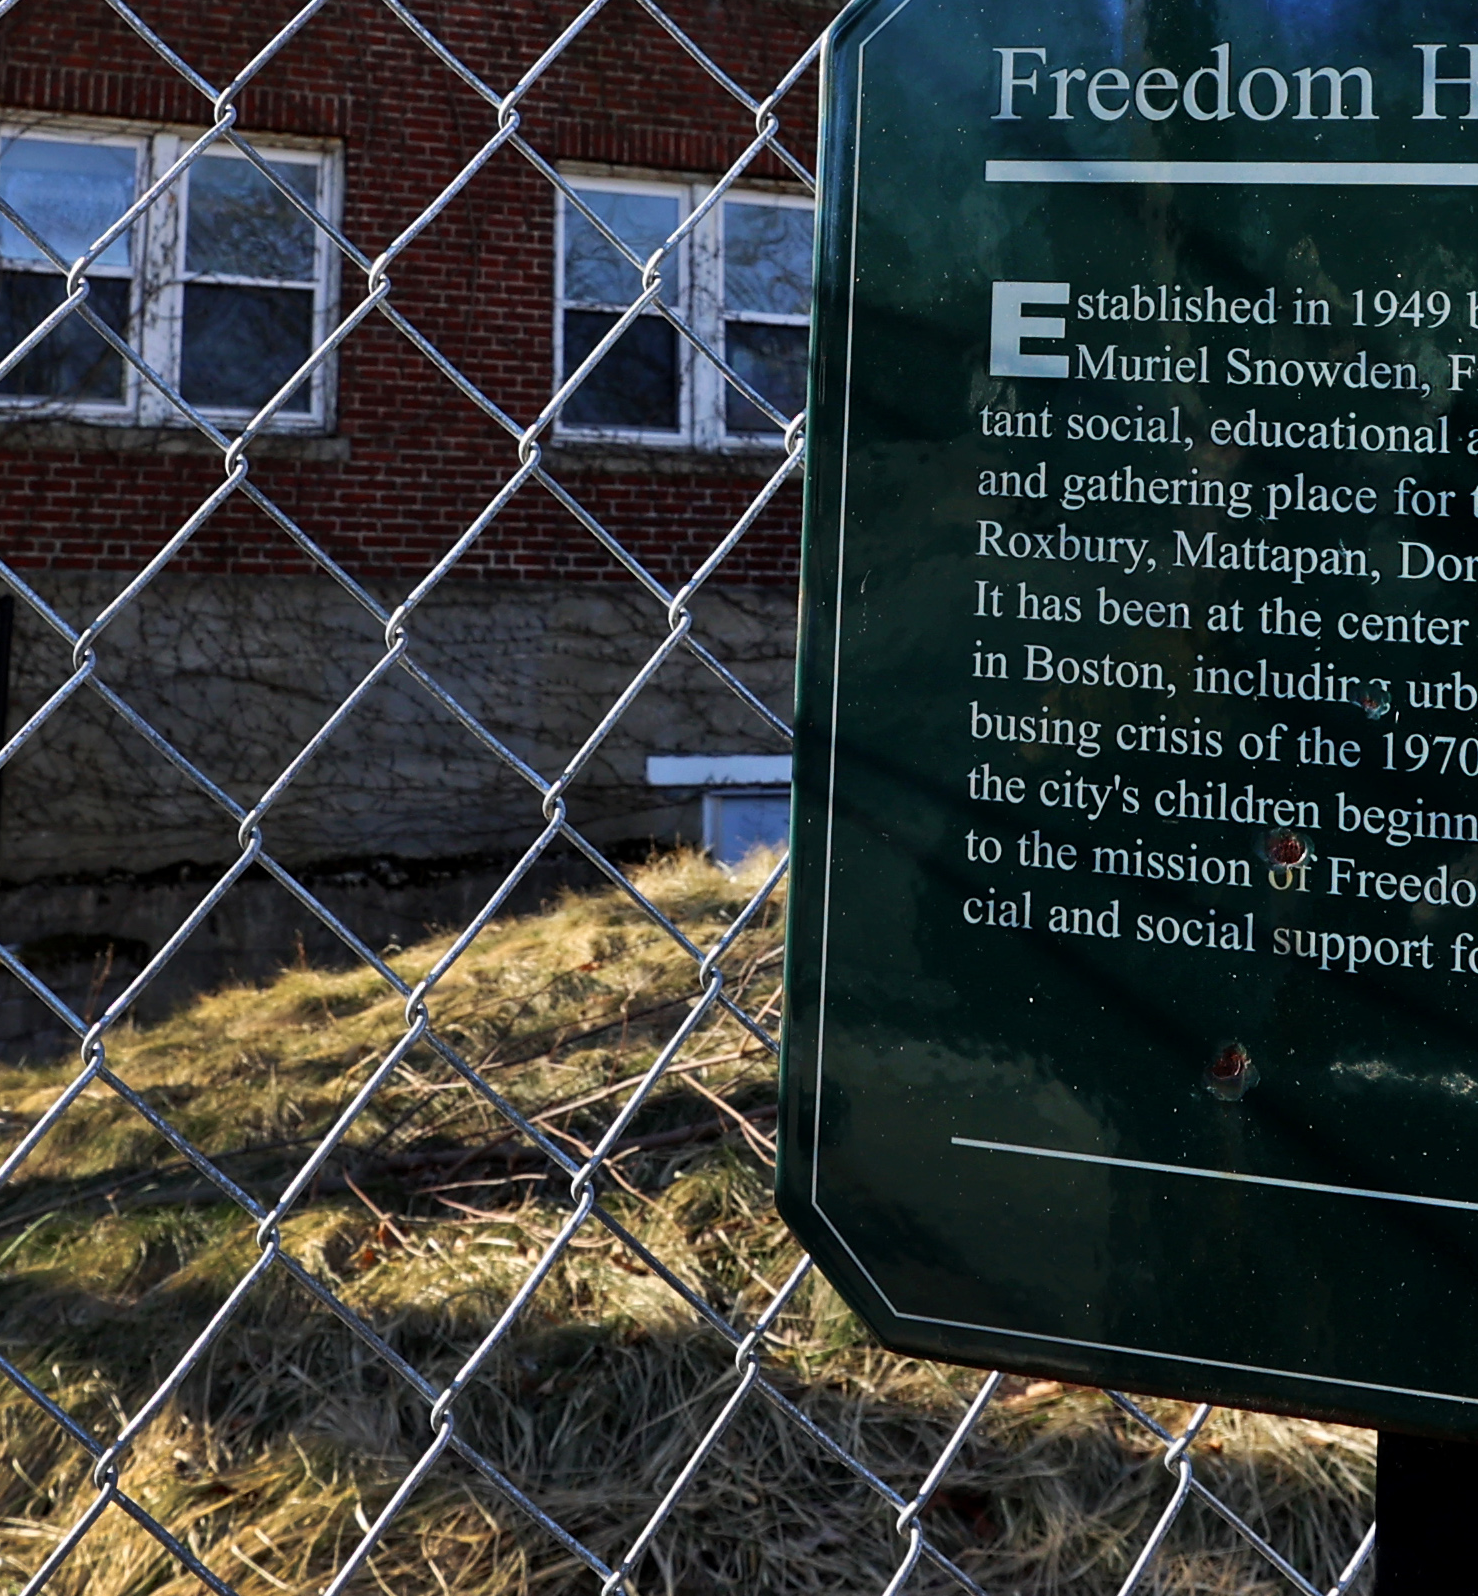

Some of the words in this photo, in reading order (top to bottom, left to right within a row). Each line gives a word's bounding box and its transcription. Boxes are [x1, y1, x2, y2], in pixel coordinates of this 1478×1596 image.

[989, 41, 1380, 122] Freedom
[1292, 286, 1332, 326] in
[1351, 288, 1452, 329] 1949
[1073, 343, 1211, 384] Muriel
[1226, 347, 1431, 399] Snowden,
[978, 401, 1054, 441] tant
[1066, 404, 1194, 452] social,
[1210, 408, 1451, 454] educational
[977, 460, 1049, 499] and
[1058, 464, 1254, 519] gathering
[1265, 472, 1378, 521] place
[1393, 476, 1457, 517] for
[974, 519, 1157, 575] Roxbury,
[1171, 529, 1381, 586] Mattapan,
[973, 579, 1004, 618] It
[1015, 581, 1082, 623] has
[1095, 585, 1193, 630] been
[1206, 599, 1245, 633] at
[1257, 596, 1322, 638] the
[1337, 609, 1470, 646] center
[971, 639, 1010, 680] in
[1022, 644, 1177, 699] Boston,
[968, 700, 1102, 759] busing
[1115, 714, 1223, 758] crisis
[1238, 722, 1289, 762] of
[1296, 725, 1361, 768] the
[966, 762, 1026, 804] the
[1039, 769, 1140, 821] city's
[1154, 778, 1322, 830] children
[964, 828, 1003, 864] to
[1016, 829, 1078, 871] the
[1091, 837, 1253, 888] mission
[962, 886, 1033, 930] cial
[1048, 899, 1122, 939] and
[1136, 908, 1257, 953] social
[1272, 927, 1435, 974] support
